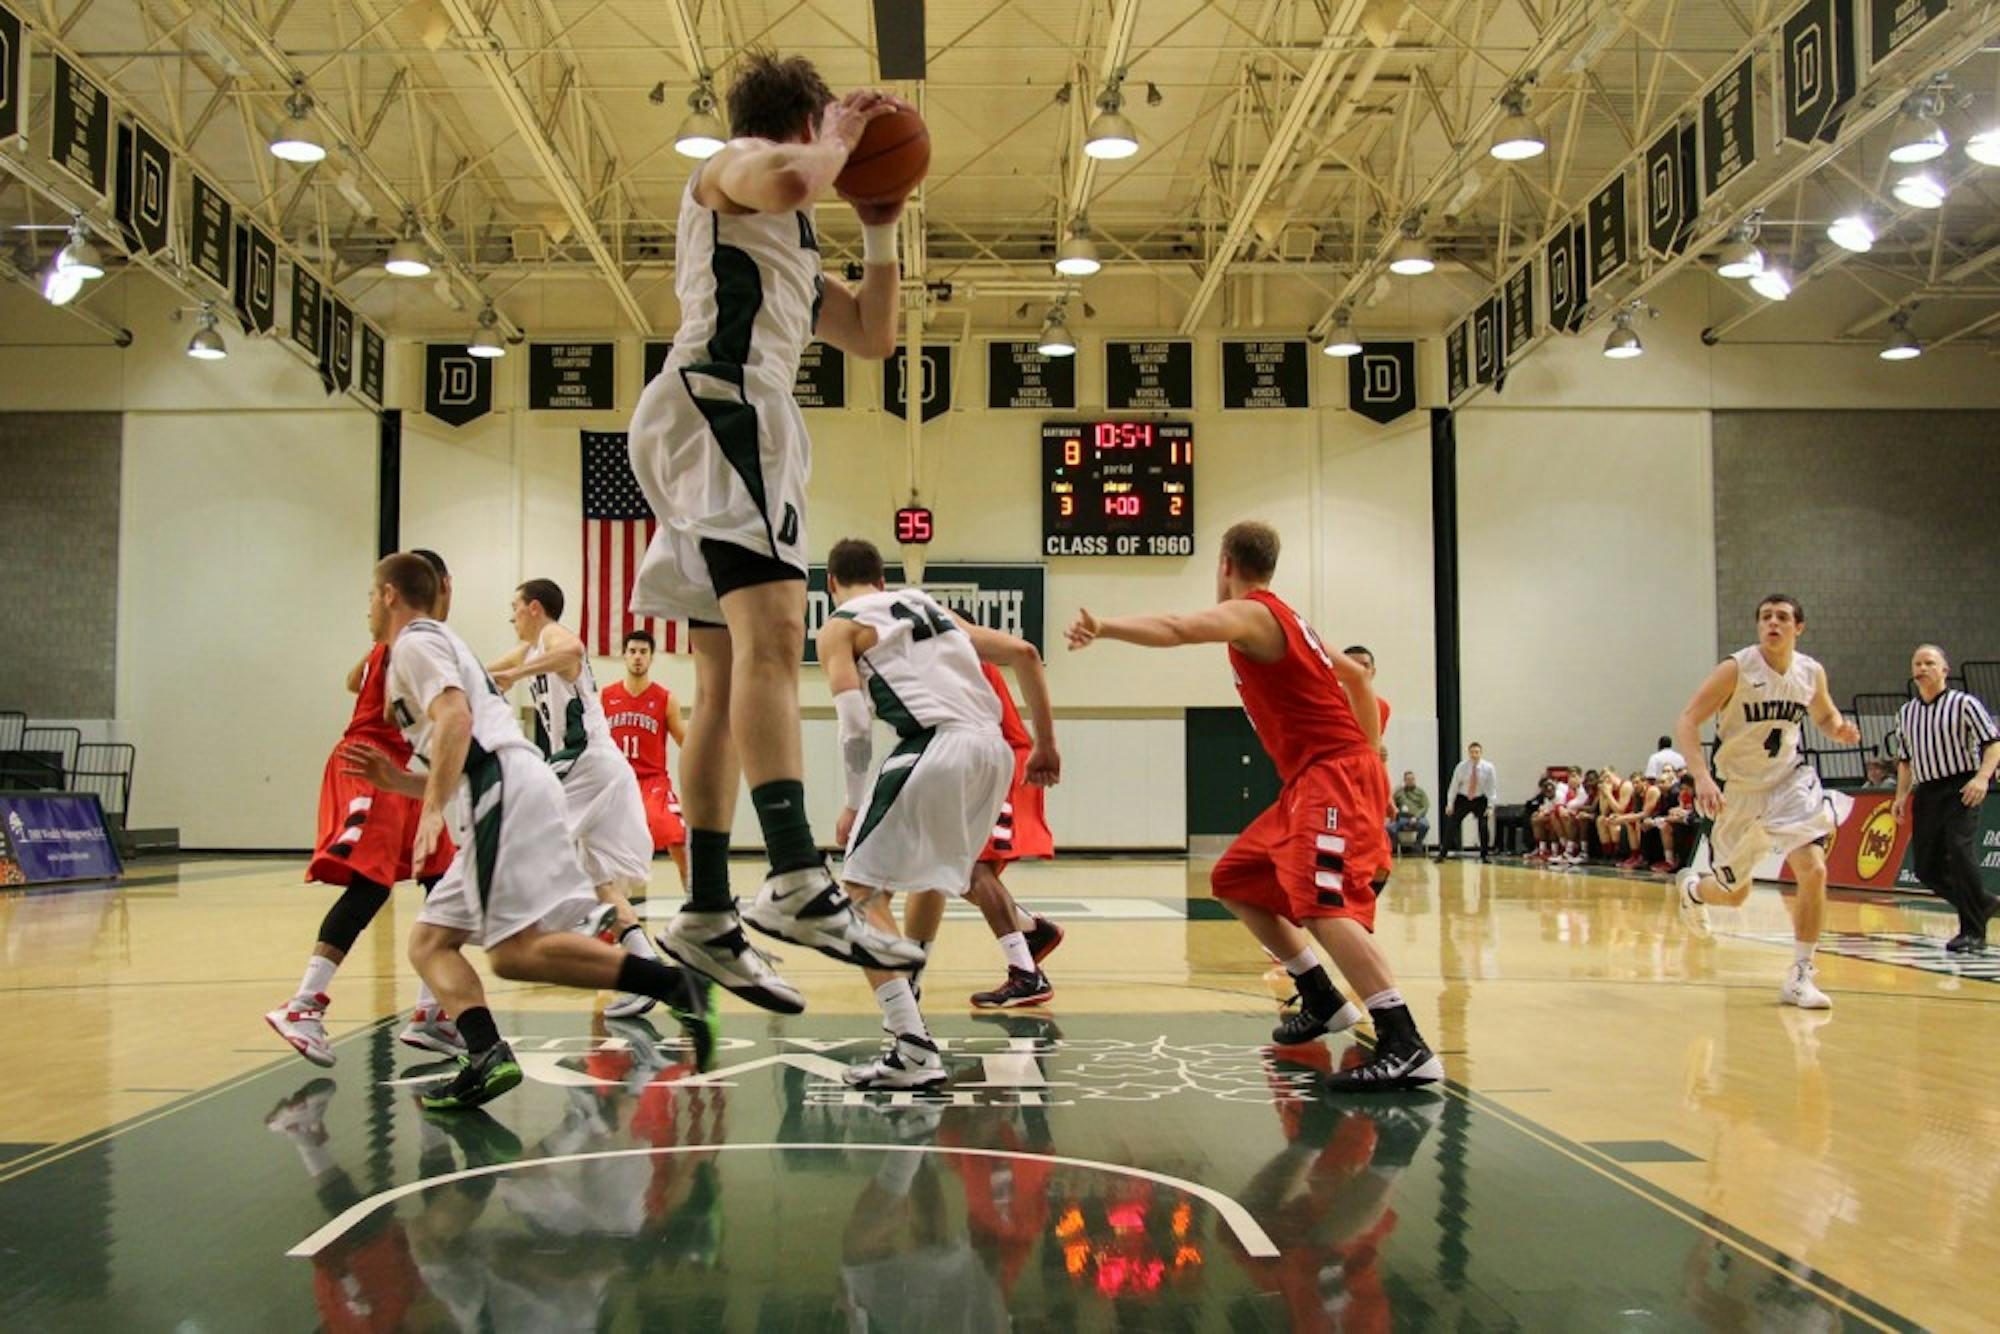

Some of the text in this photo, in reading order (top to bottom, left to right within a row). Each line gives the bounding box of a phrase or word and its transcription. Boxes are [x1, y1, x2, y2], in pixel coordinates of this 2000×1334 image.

[439, 357, 477, 405] D
[1363, 354, 1400, 402] D
[1095, 423, 1151, 448] 10:54
[1064, 439, 1081, 466] 8
[1171, 441, 1192, 465] 11
[1060, 496, 1073, 516] 3
[1170, 496, 1182, 516] 2
[898, 510, 931, 540] 35
[1046, 535, 1191, 555] CLASS OF 1960
[622, 735, 641, 760] 11
[1763, 727, 1783, 759] 4
